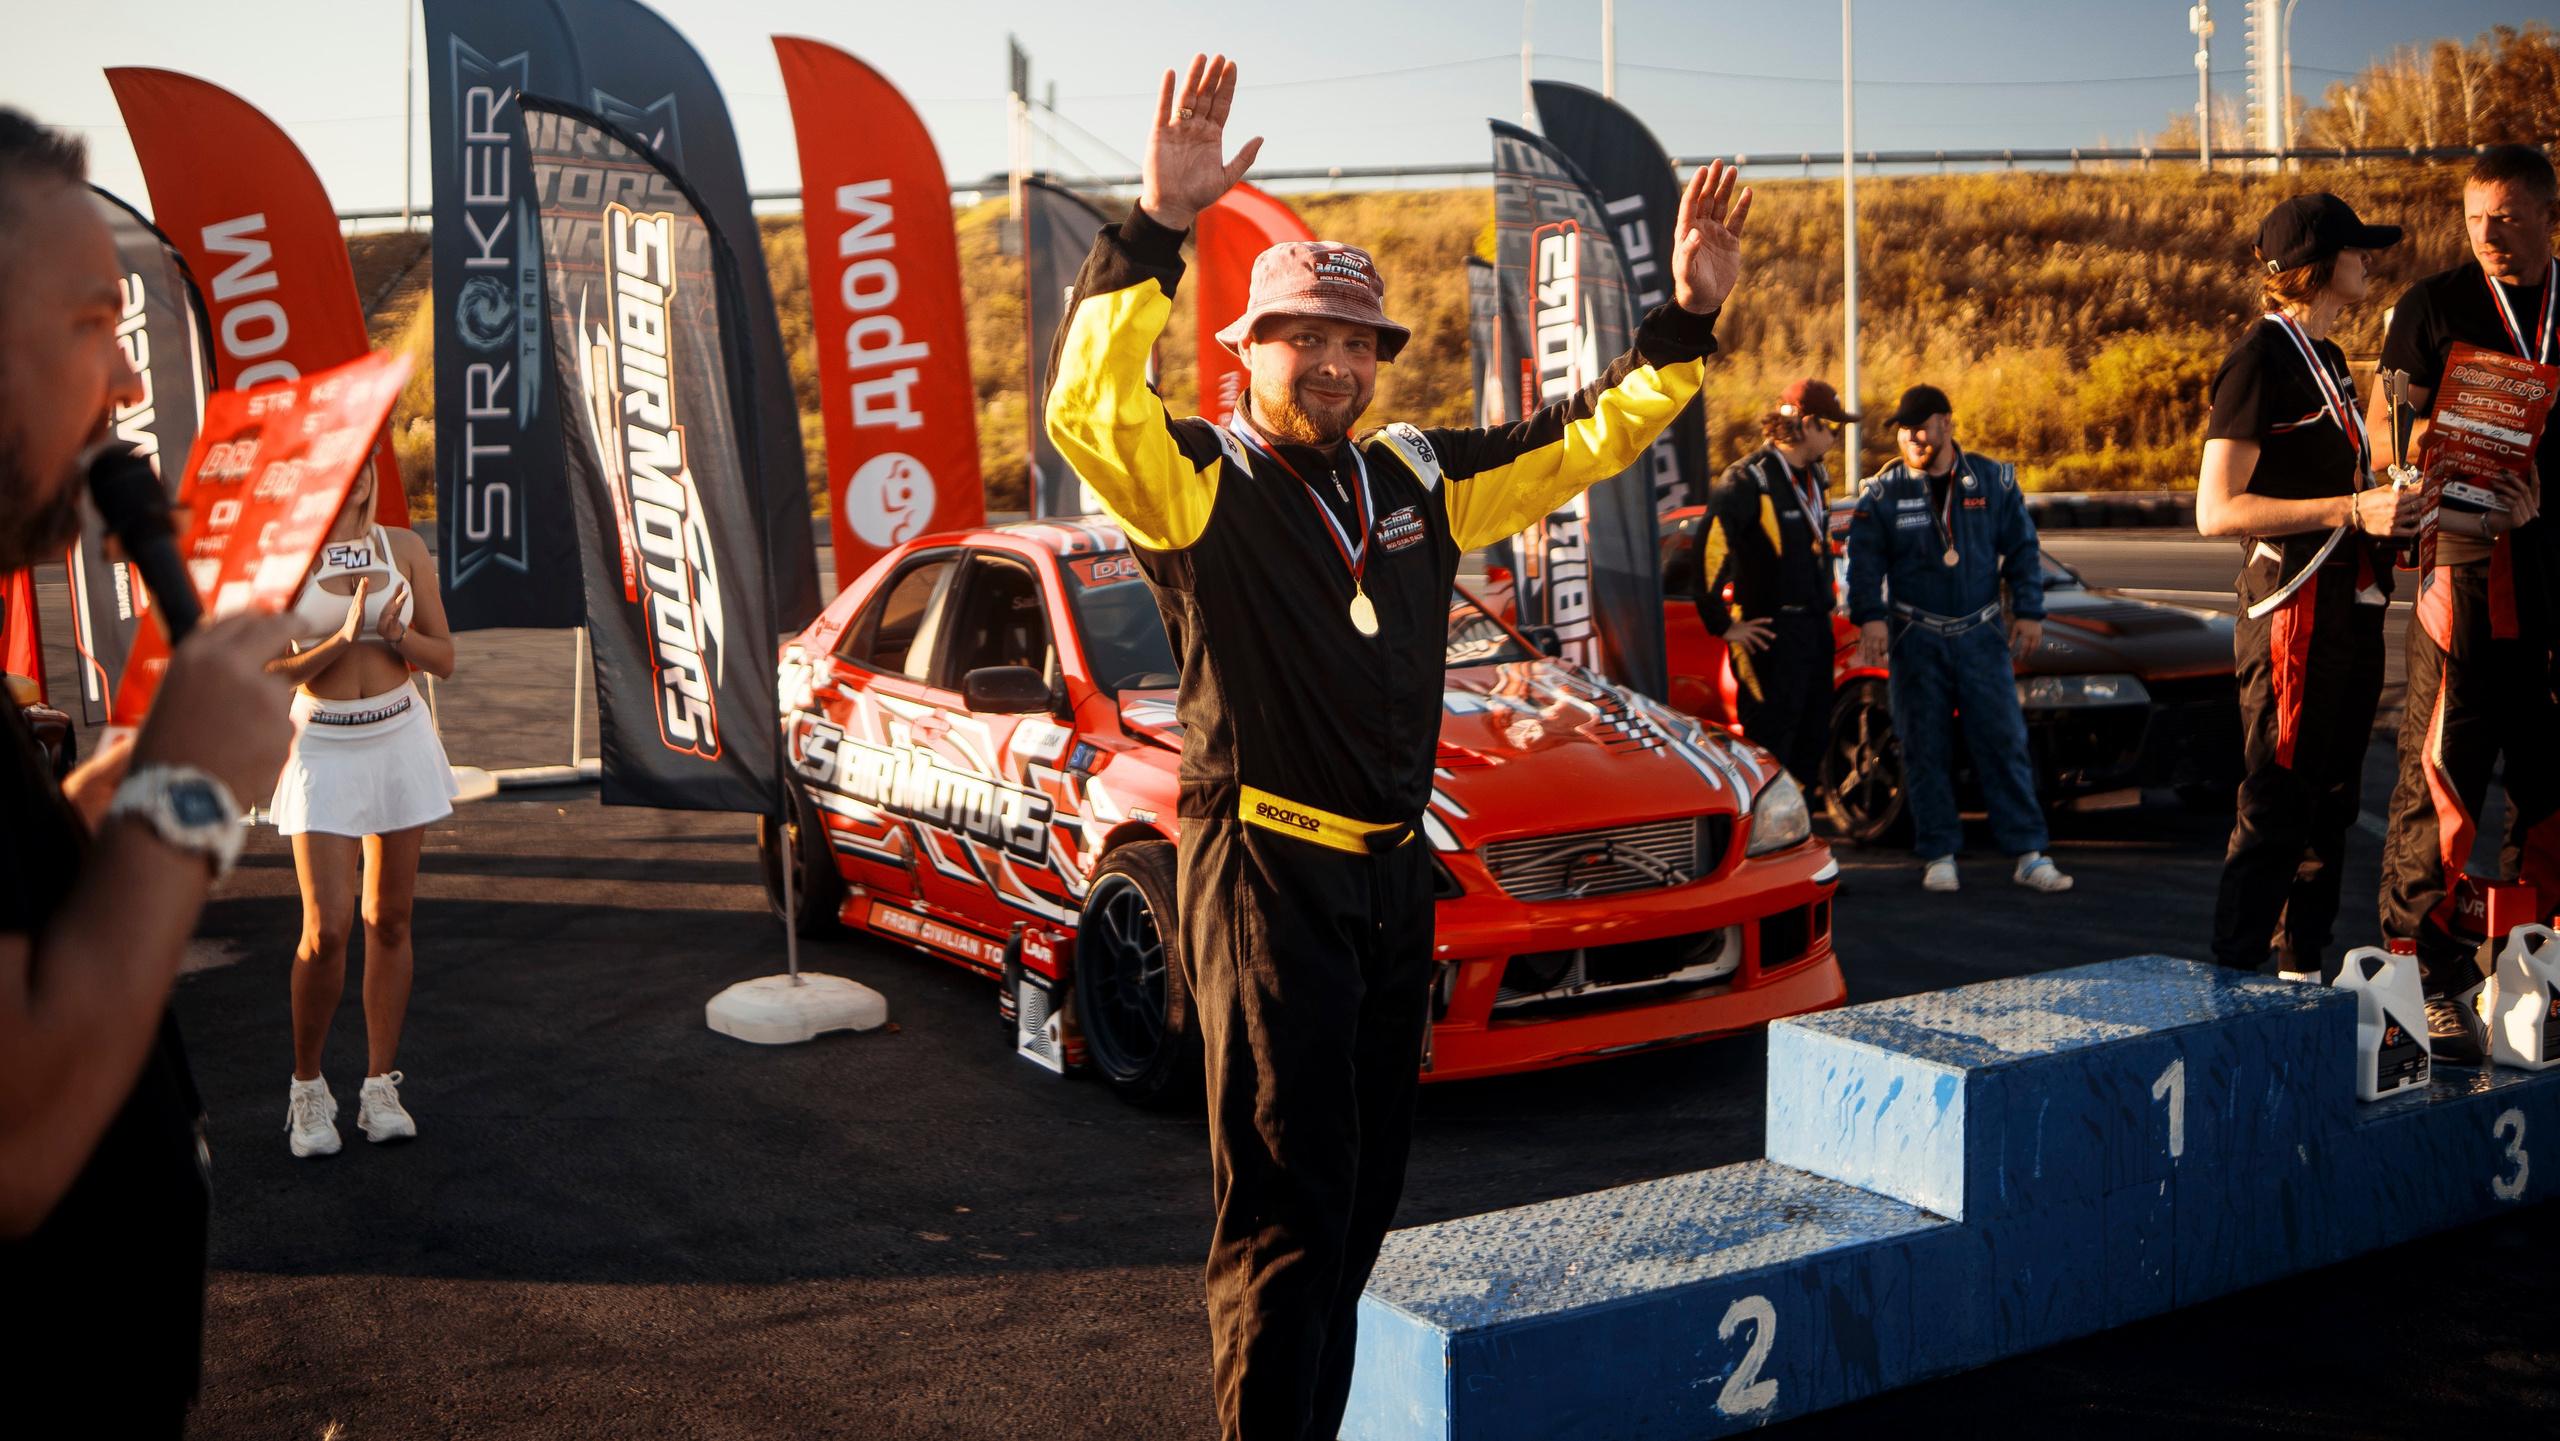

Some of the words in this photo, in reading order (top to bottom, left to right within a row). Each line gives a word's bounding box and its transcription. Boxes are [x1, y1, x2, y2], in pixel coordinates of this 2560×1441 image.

[1315, 262, 1370, 284] MOTORS
[2450, 365, 2501, 390] DRIFT
[2501, 378, 2547, 402] LETO
[1397, 425, 1437, 464] sparco
[2450, 431, 2461, 442] 3
[2463, 435, 2510, 455] МЕСТО
[1377, 520, 1423, 543] MOTORS
[330, 547, 370, 569] SM
[1256, 801, 1321, 831] sparco
[880, 910, 918, 935] FROM
[920, 921, 979, 956] CIVILIAN
[983, 943, 1004, 964] TO
[2151, 1057, 2185, 1158] 1
[2492, 1105, 2530, 1201] 3
[1716, 1294, 1779, 1416] 2
